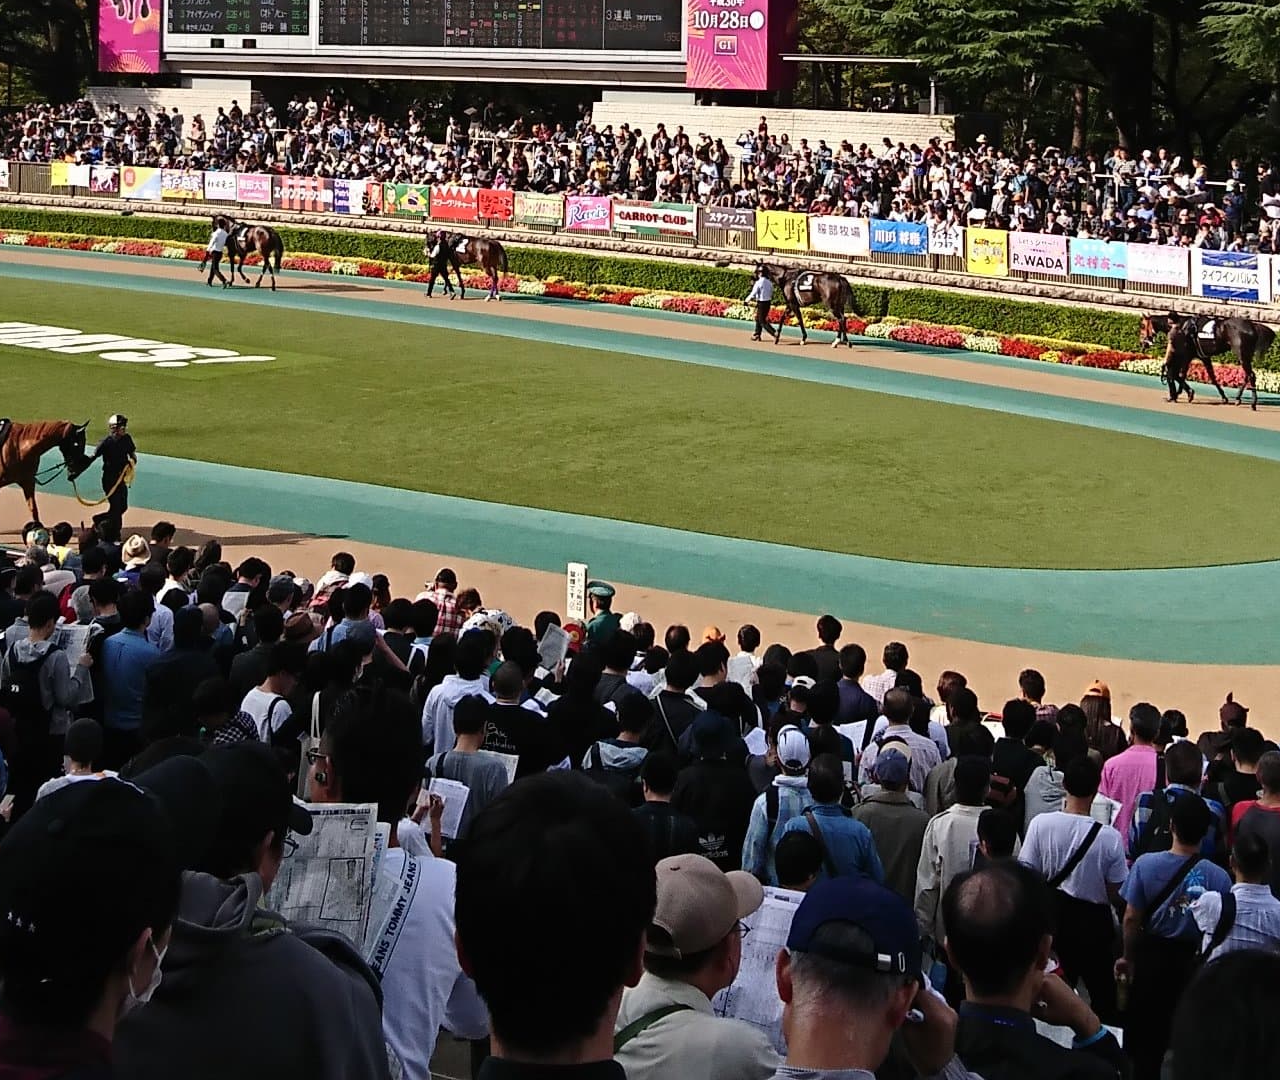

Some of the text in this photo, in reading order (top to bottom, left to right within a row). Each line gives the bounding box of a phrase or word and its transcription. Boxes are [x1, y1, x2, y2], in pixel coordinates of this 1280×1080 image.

[606, 10, 632, 20] 3連単
[693, 10, 749, 29] 10月28日
[482, 206, 512, 217] デムーロ
[619, 211, 659, 223] CARROT
[662, 214, 687, 225] CLUB
[761, 216, 805, 243] 大野
[817, 223, 860, 238] 服部牧場
[1013, 253, 1064, 270] R.WADA
[370, 860, 417, 973] EANS TOMMY JEANS
